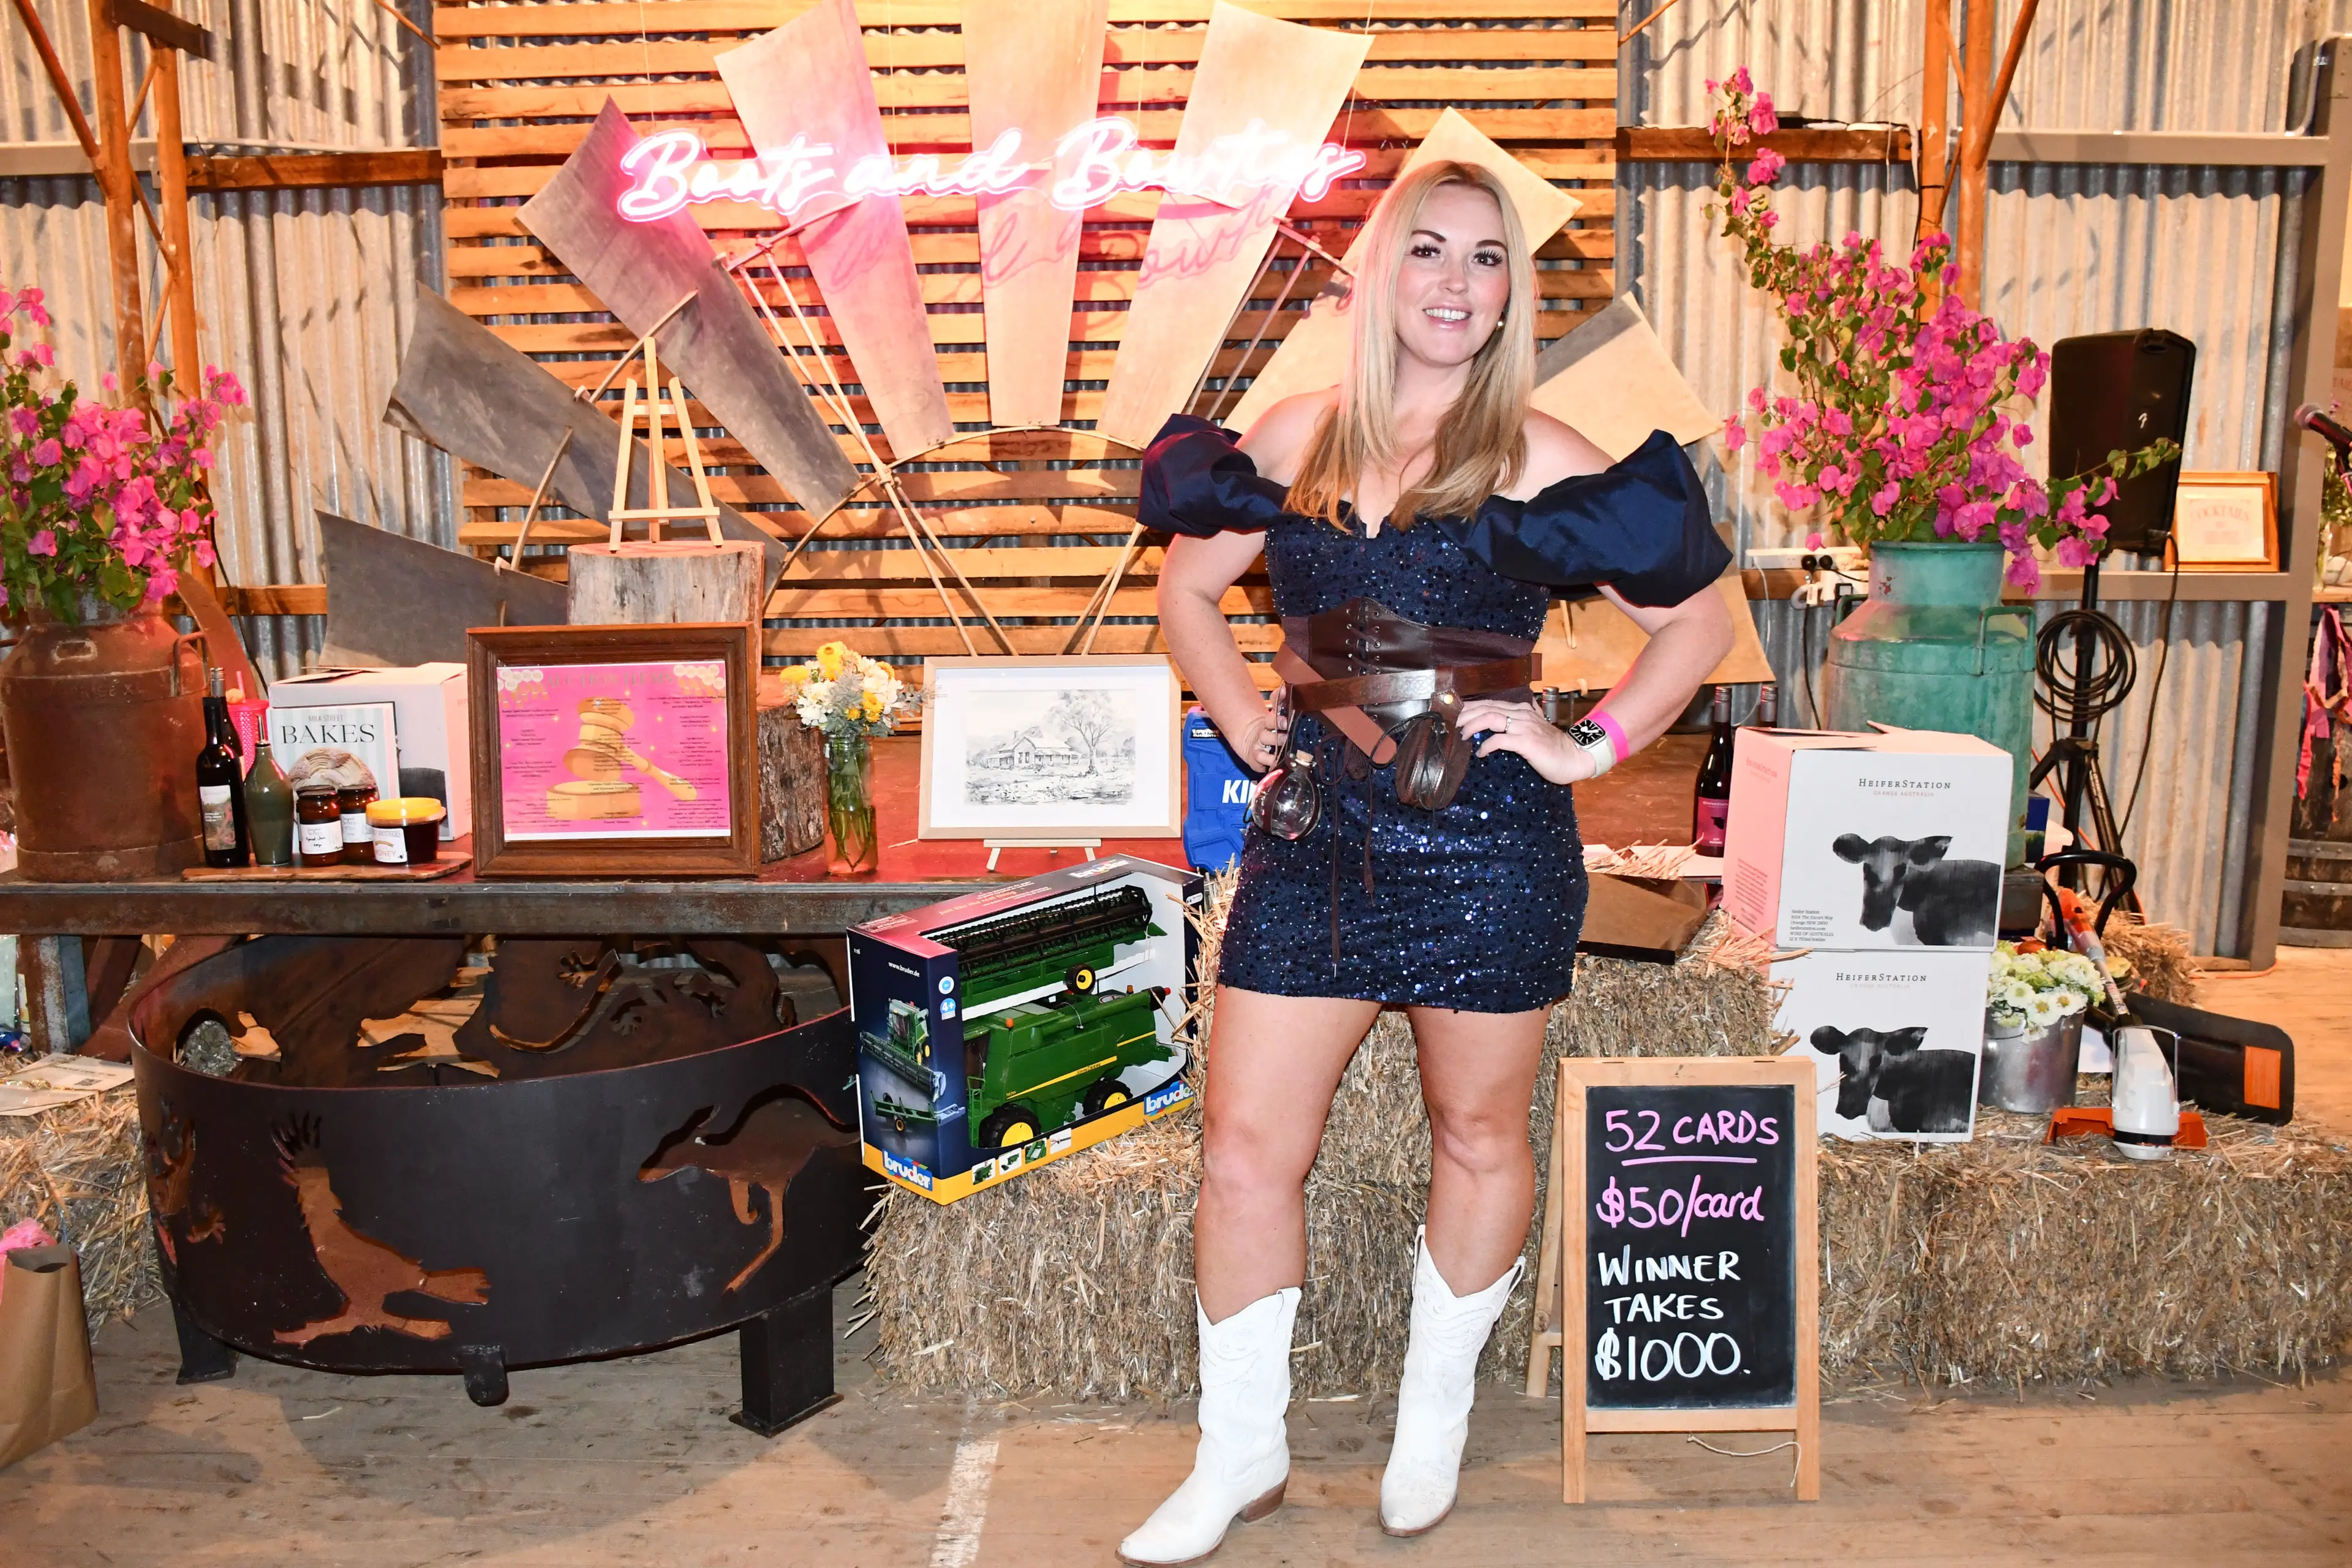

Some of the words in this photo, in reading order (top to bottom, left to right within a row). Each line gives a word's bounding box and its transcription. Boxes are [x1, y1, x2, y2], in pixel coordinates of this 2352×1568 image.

[619, 129, 837, 219] Boots
[843, 127, 1035, 196] and
[281, 724, 375, 744] BAKES
[888, 962, 920, 978] www.bruder.de
[1605, 1109, 1665, 1152] 52
[1673, 1109, 1779, 1145] CARDS
[884, 1150, 930, 1189] bruder
[1596, 1174, 1765, 1238] $50/card
[1597, 1244, 1741, 1287] WINNER
[1604, 1292, 1724, 1324] TAKES
